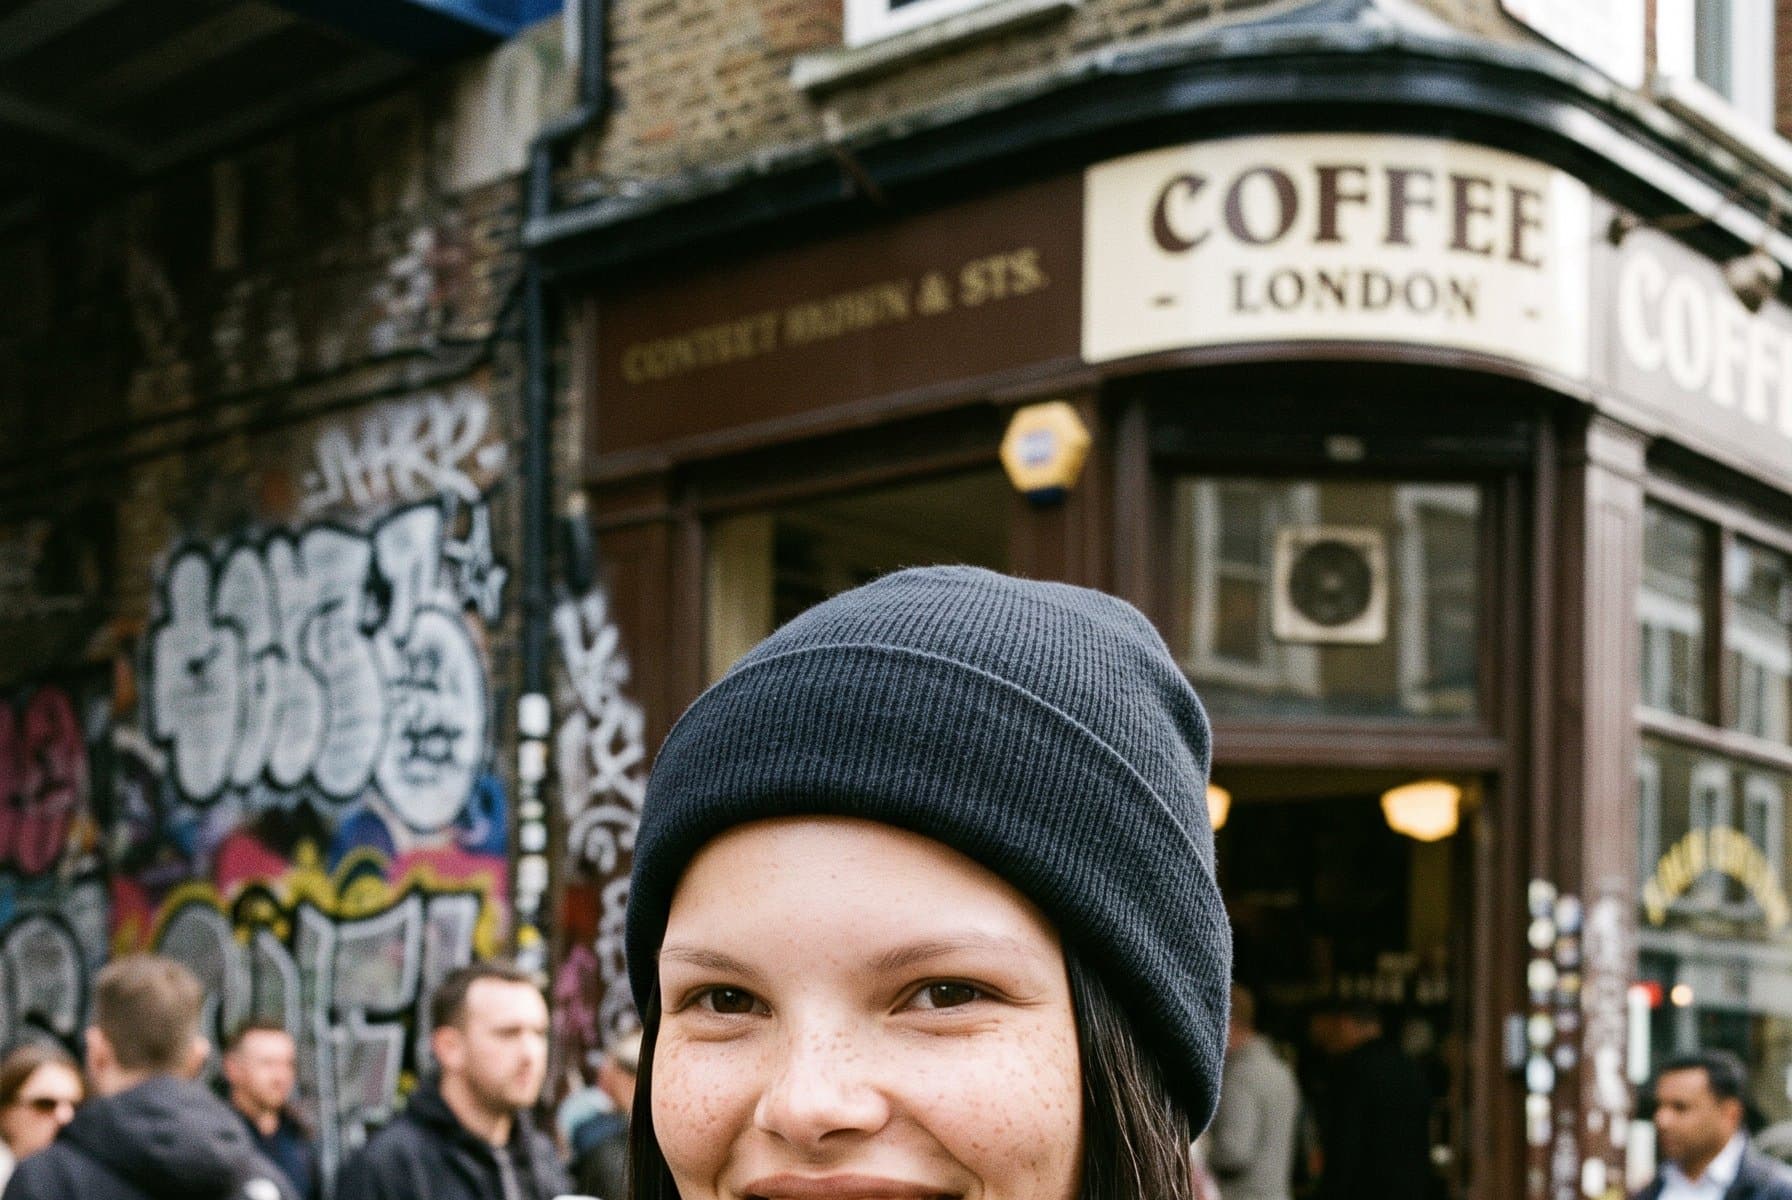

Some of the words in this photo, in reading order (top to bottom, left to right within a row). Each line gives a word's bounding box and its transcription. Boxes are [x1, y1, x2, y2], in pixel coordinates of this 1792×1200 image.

[1152, 164, 1543, 269] COFFEE
[1232, 266, 1480, 321] LONDON
[1618, 254, 1792, 439] COFF
